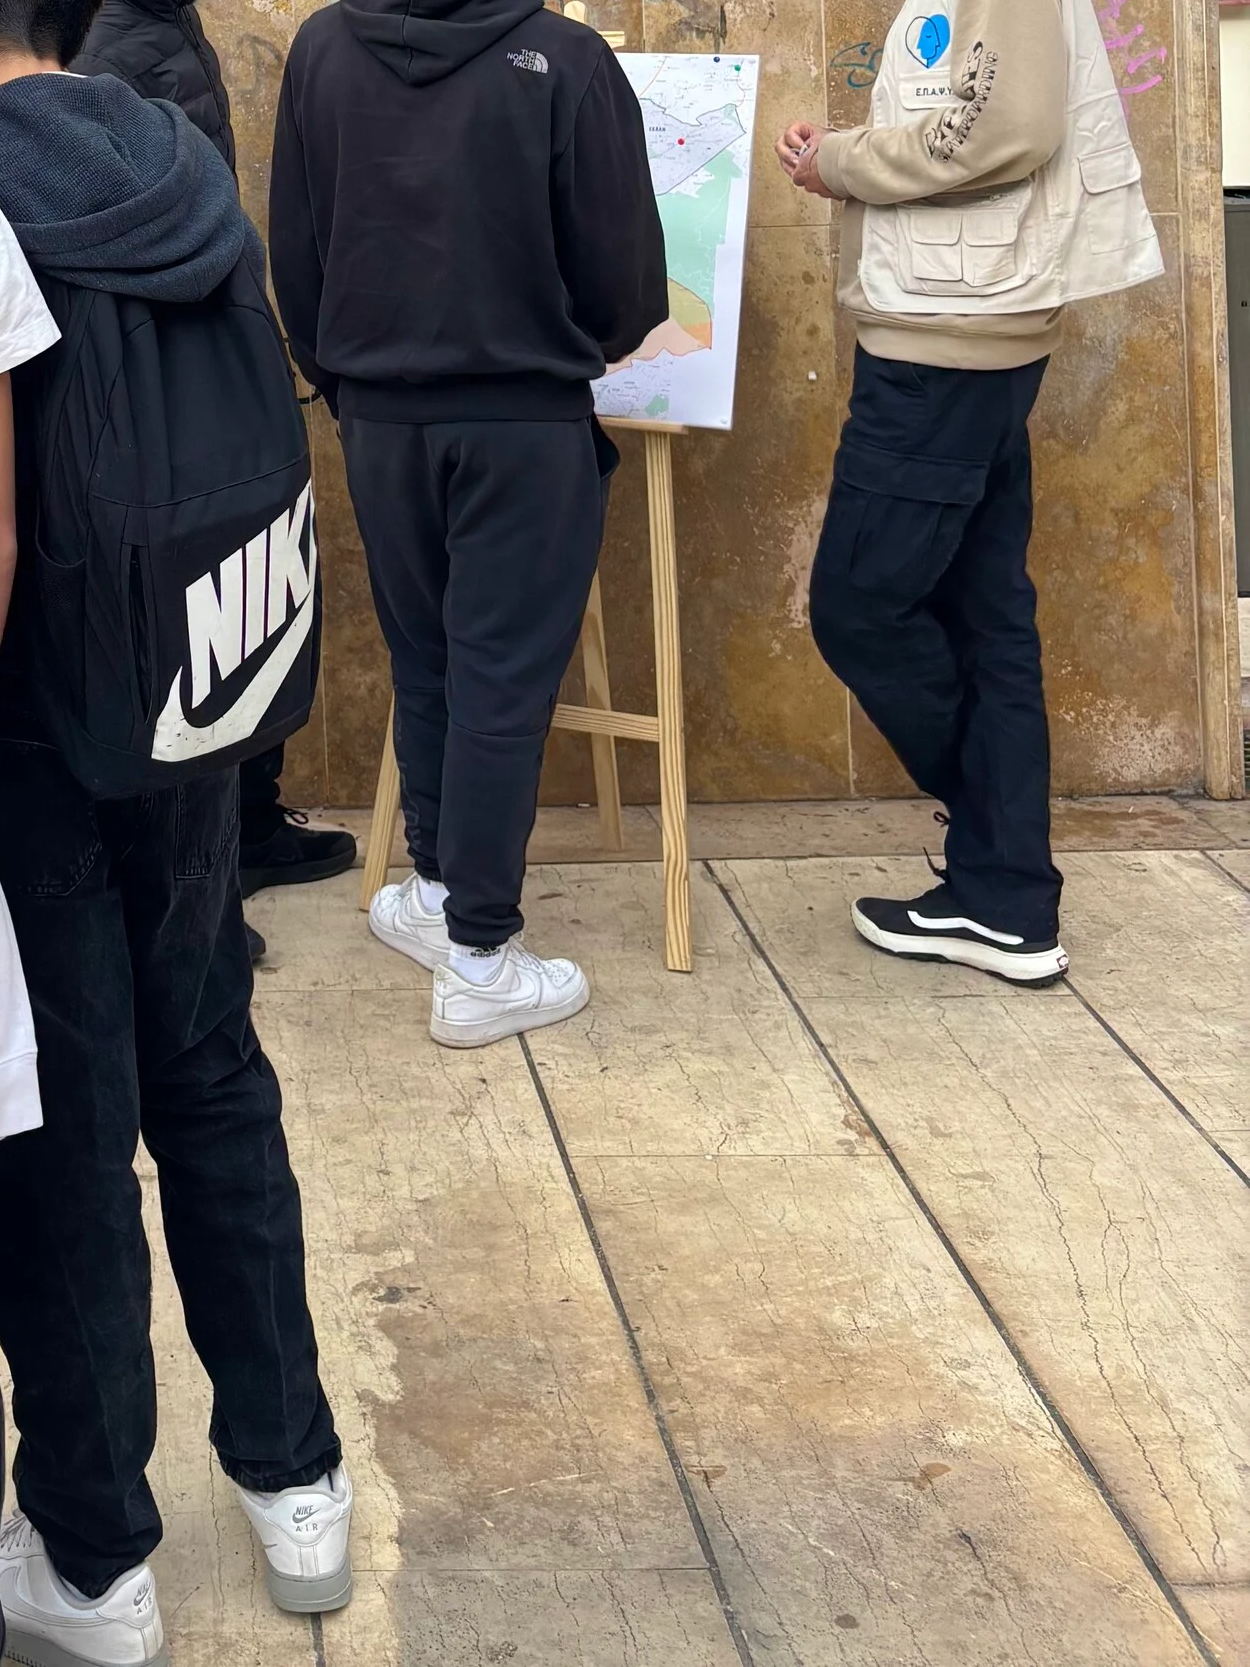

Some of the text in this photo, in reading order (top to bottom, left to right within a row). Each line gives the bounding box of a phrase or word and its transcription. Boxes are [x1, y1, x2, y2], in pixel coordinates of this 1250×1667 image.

[507, 51, 535, 66] NORTH
[521, 48, 537, 57] THE
[513, 58, 533, 71] FACE
[185, 477, 317, 709] NIK
[295, 1504, 314, 1516] NIKE
[296, 1523, 318, 1532] AIR
